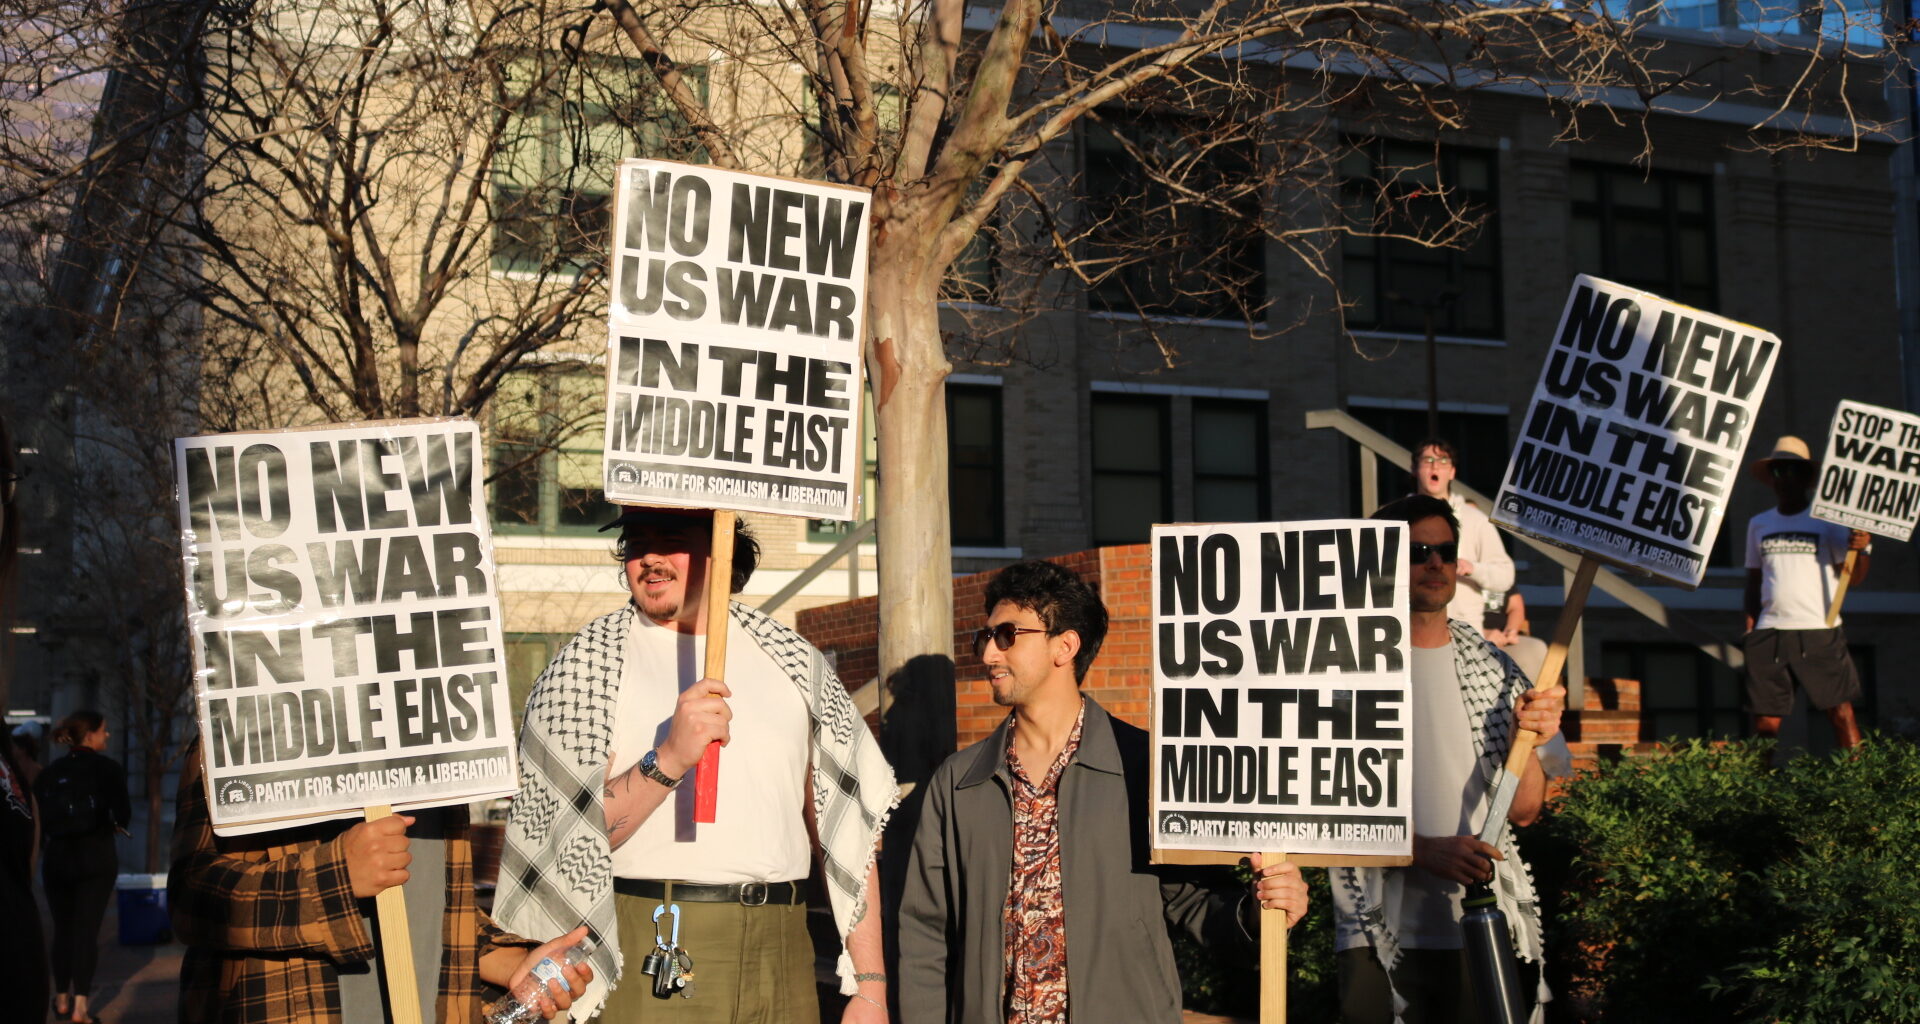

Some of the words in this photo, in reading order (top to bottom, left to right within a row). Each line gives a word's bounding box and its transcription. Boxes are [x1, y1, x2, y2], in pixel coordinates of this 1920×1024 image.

[625, 168, 712, 257] NO
[727, 182, 865, 280] NEW
[619, 255, 708, 322] US
[715, 266, 857, 342] WAR
[616, 335, 700, 393] IN
[708, 345, 852, 411] THE
[1559, 285, 1642, 361] NO
[1642, 309, 1775, 401] NEW
[611, 392, 756, 465] MIDDLE
[763, 408, 849, 474] EAST
[1545, 349, 1622, 410] US
[1624, 371, 1750, 452] WAR
[1838, 408, 1894, 441] STOP
[1898, 422, 1920, 450] TH
[185, 443, 292, 543] NO
[310, 431, 473, 534] NEW
[640, 470, 680, 490] PARTY
[682, 474, 705, 494] FOR
[707, 476, 768, 500] SOCIALISM
[771, 483, 780, 500] &
[782, 484, 845, 508] LIBERATION
[1526, 399, 1603, 456] IN
[1606, 421, 1734, 498] THE
[1834, 433, 1920, 477] WAR
[1508, 441, 1637, 521] MIDDLE
[1632, 482, 1721, 547] EAST
[1820, 464, 1858, 506] ON
[1856, 472, 1920, 522] IRAN!
[194, 543, 303, 620] US
[306, 532, 488, 608] WAR
[1159, 533, 1241, 617] NO
[1260, 526, 1401, 613] NEW
[1524, 506, 1557, 527] PARTY
[1556, 516, 1578, 535] FOR
[1577, 523, 1633, 553] SOCIALISM
[1631, 541, 1641, 554] &
[1642, 544, 1700, 575] LIBERATION
[203, 629, 305, 690] IN
[312, 606, 495, 678] THE
[1158, 619, 1244, 681] US
[1249, 615, 1404, 676] WAR
[208, 682, 386, 769] MIDDLE
[394, 671, 498, 748] EAST
[1161, 688, 1239, 738] IN
[1248, 688, 1404, 741] THE
[255, 779, 301, 804] PARTY
[304, 776, 333, 799] FOR
[336, 766, 412, 795] SOCIALISM
[415, 765, 426, 785] &
[428, 756, 508, 784] LIBERATION
[1160, 744, 1299, 805] MIDDLE
[1311, 747, 1404, 808] EAST
[1190, 819, 1226, 837] PARTY
[1228, 821, 1251, 838] FOR
[1253, 821, 1318, 841] SOCIALISM
[1321, 823, 1331, 841] &
[1334, 823, 1404, 842] LIBERATION
